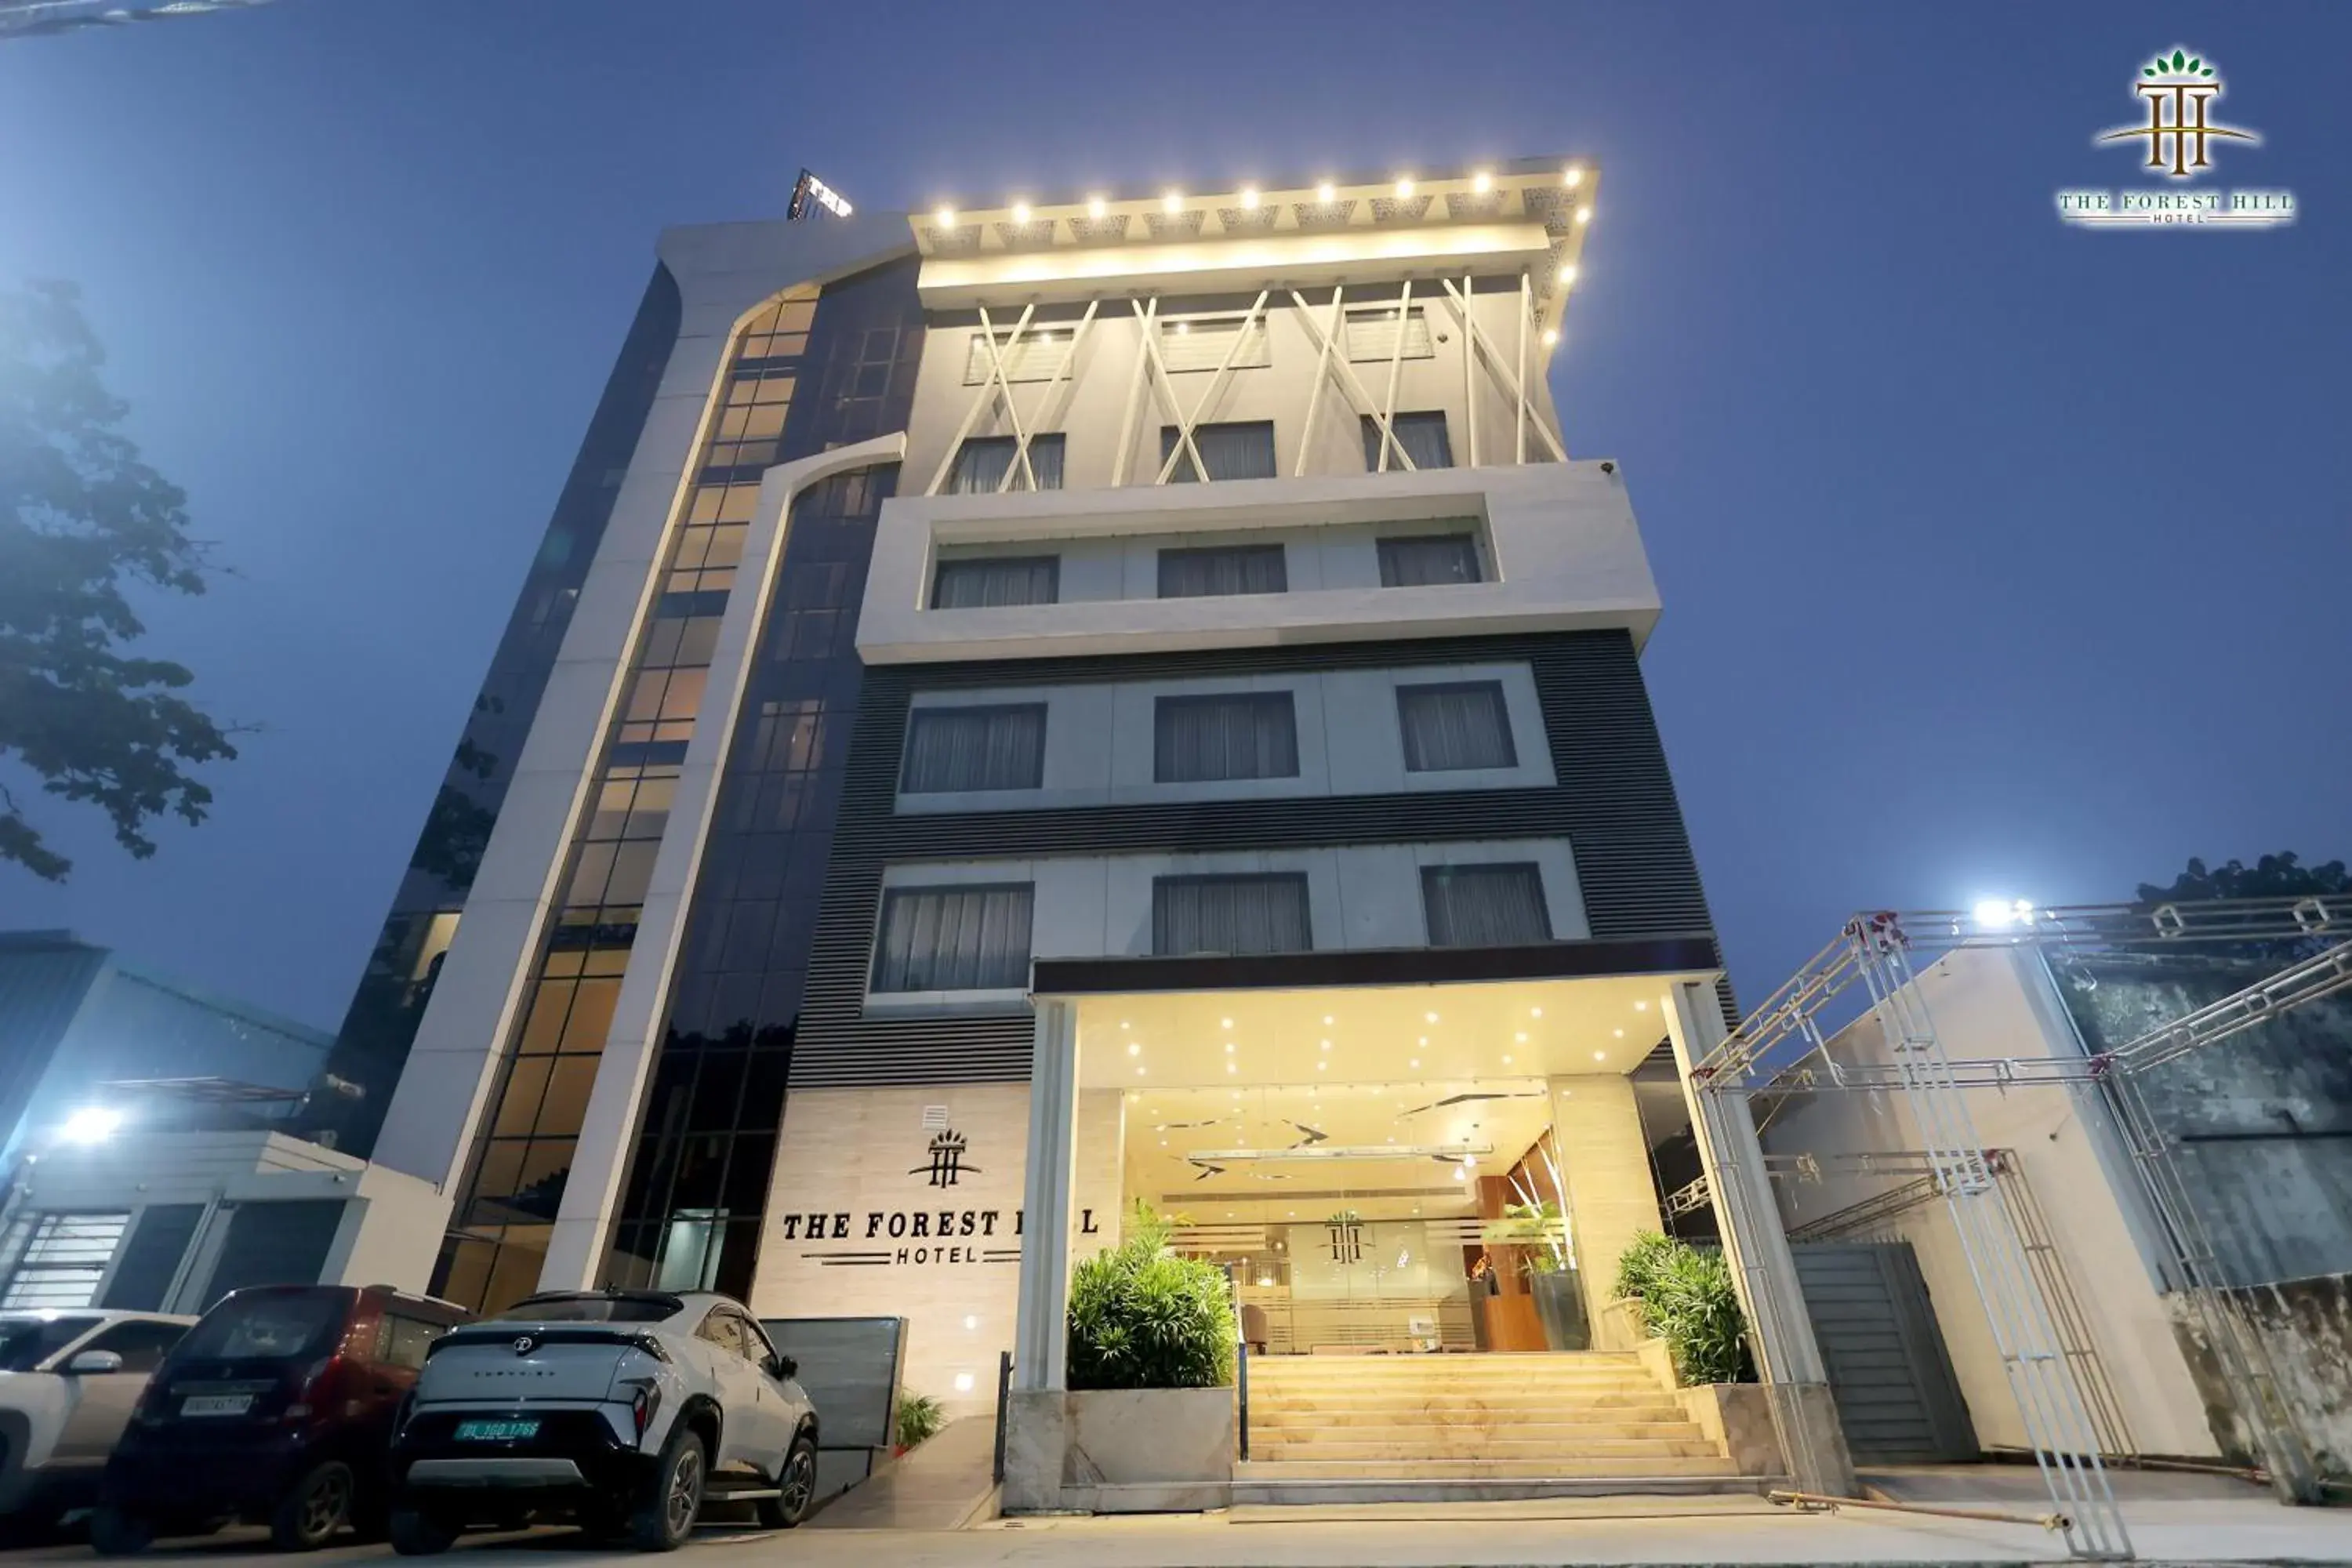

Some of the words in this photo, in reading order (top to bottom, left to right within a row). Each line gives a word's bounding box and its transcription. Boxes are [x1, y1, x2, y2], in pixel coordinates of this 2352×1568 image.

[784, 1213, 850, 1240] THE
[866, 1210, 999, 1238] FOREST
[896, 1246, 977, 1265] HOTEL
